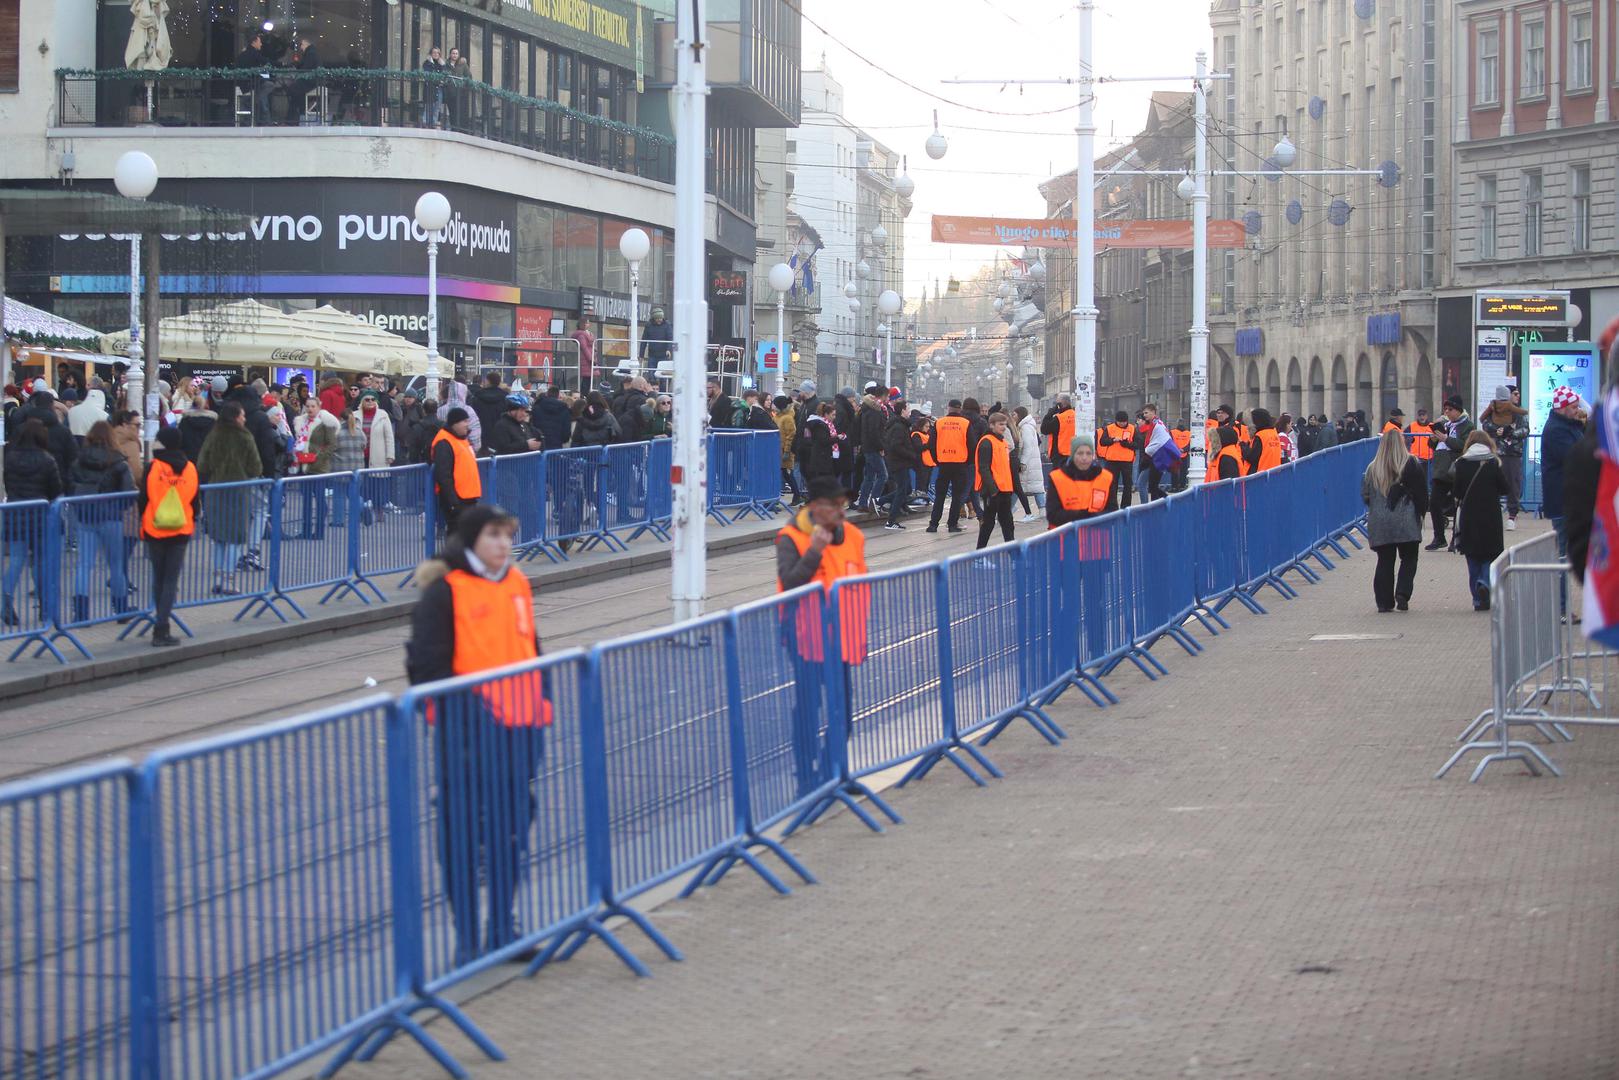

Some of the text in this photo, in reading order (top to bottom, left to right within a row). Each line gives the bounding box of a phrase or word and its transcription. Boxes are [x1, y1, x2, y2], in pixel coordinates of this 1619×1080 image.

[551, 0, 590, 33] SOMERSBY
[338, 215, 430, 249] puno
[470, 220, 510, 257] ponuda
[346, 310, 430, 331] elemac
